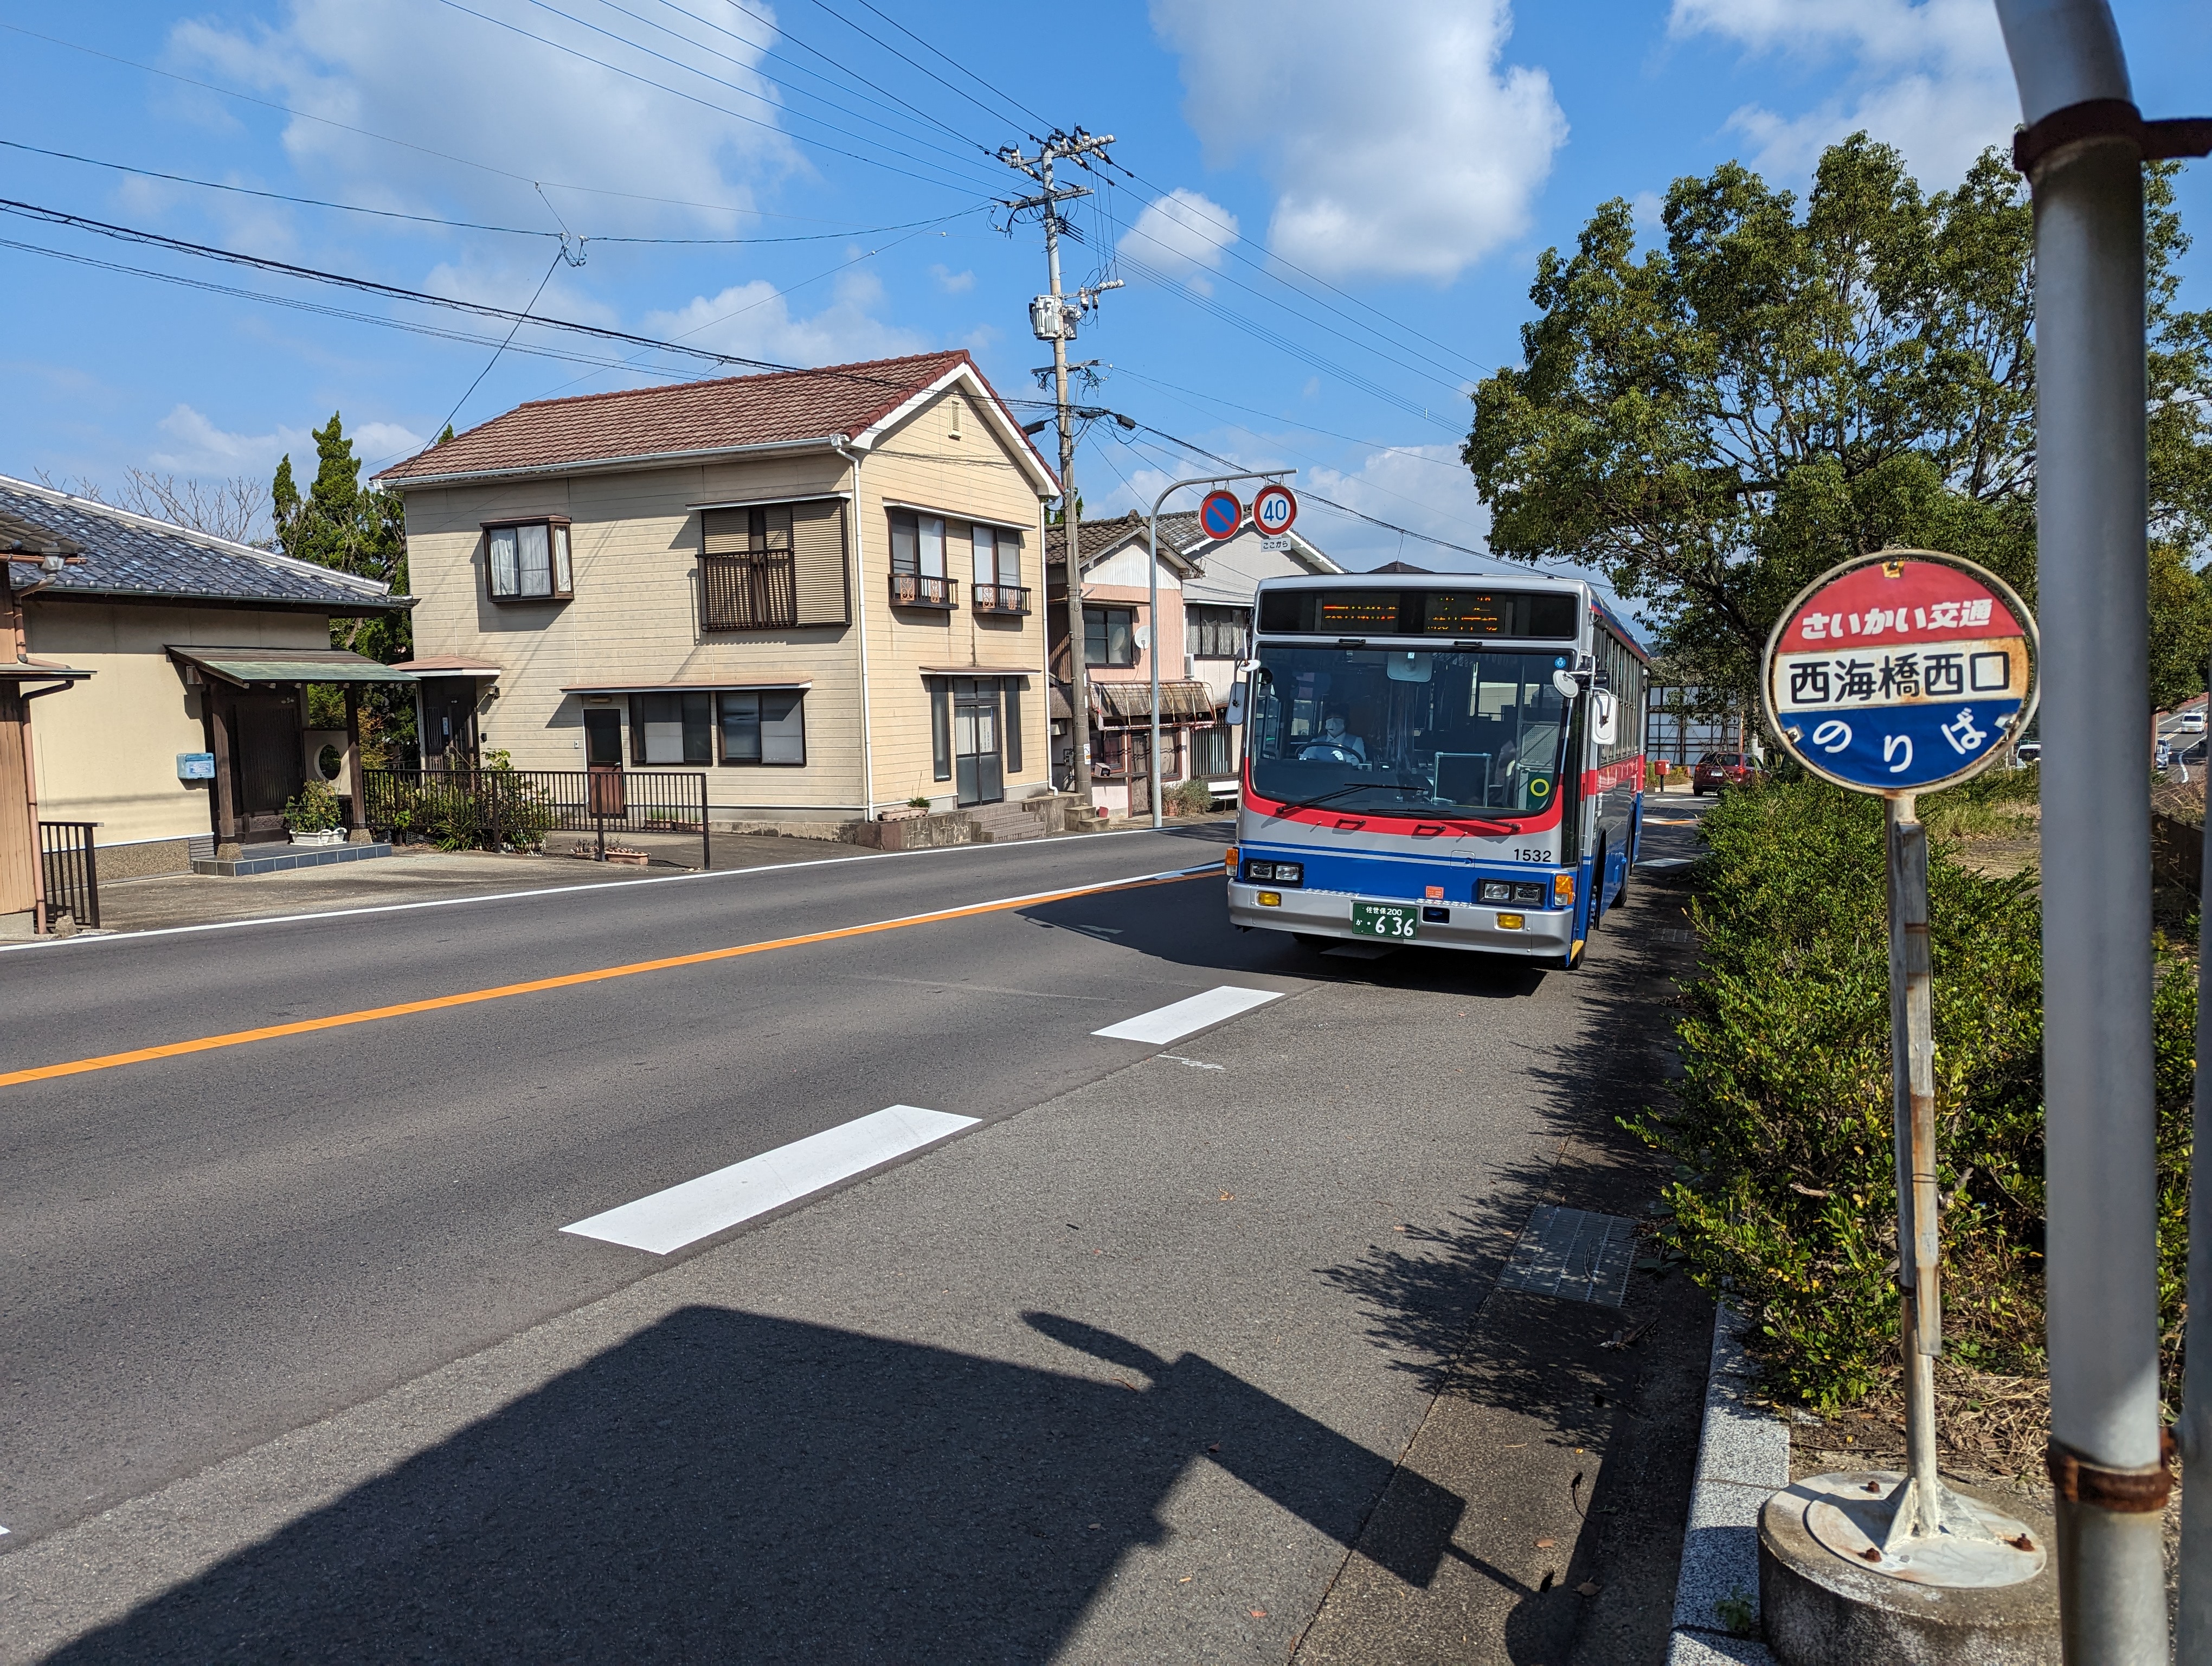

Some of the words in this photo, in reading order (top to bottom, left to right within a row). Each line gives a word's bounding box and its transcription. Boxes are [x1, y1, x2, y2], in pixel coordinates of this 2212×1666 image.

[1263, 499, 1287, 522] 40
[1263, 541, 1288, 549] ここから
[1801, 598, 1993, 639] さいかい交通
[1789, 651, 2010, 704] 西海橋西口
[1812, 707, 1988, 773] のりば
[1514, 848, 1552, 862] 1532
